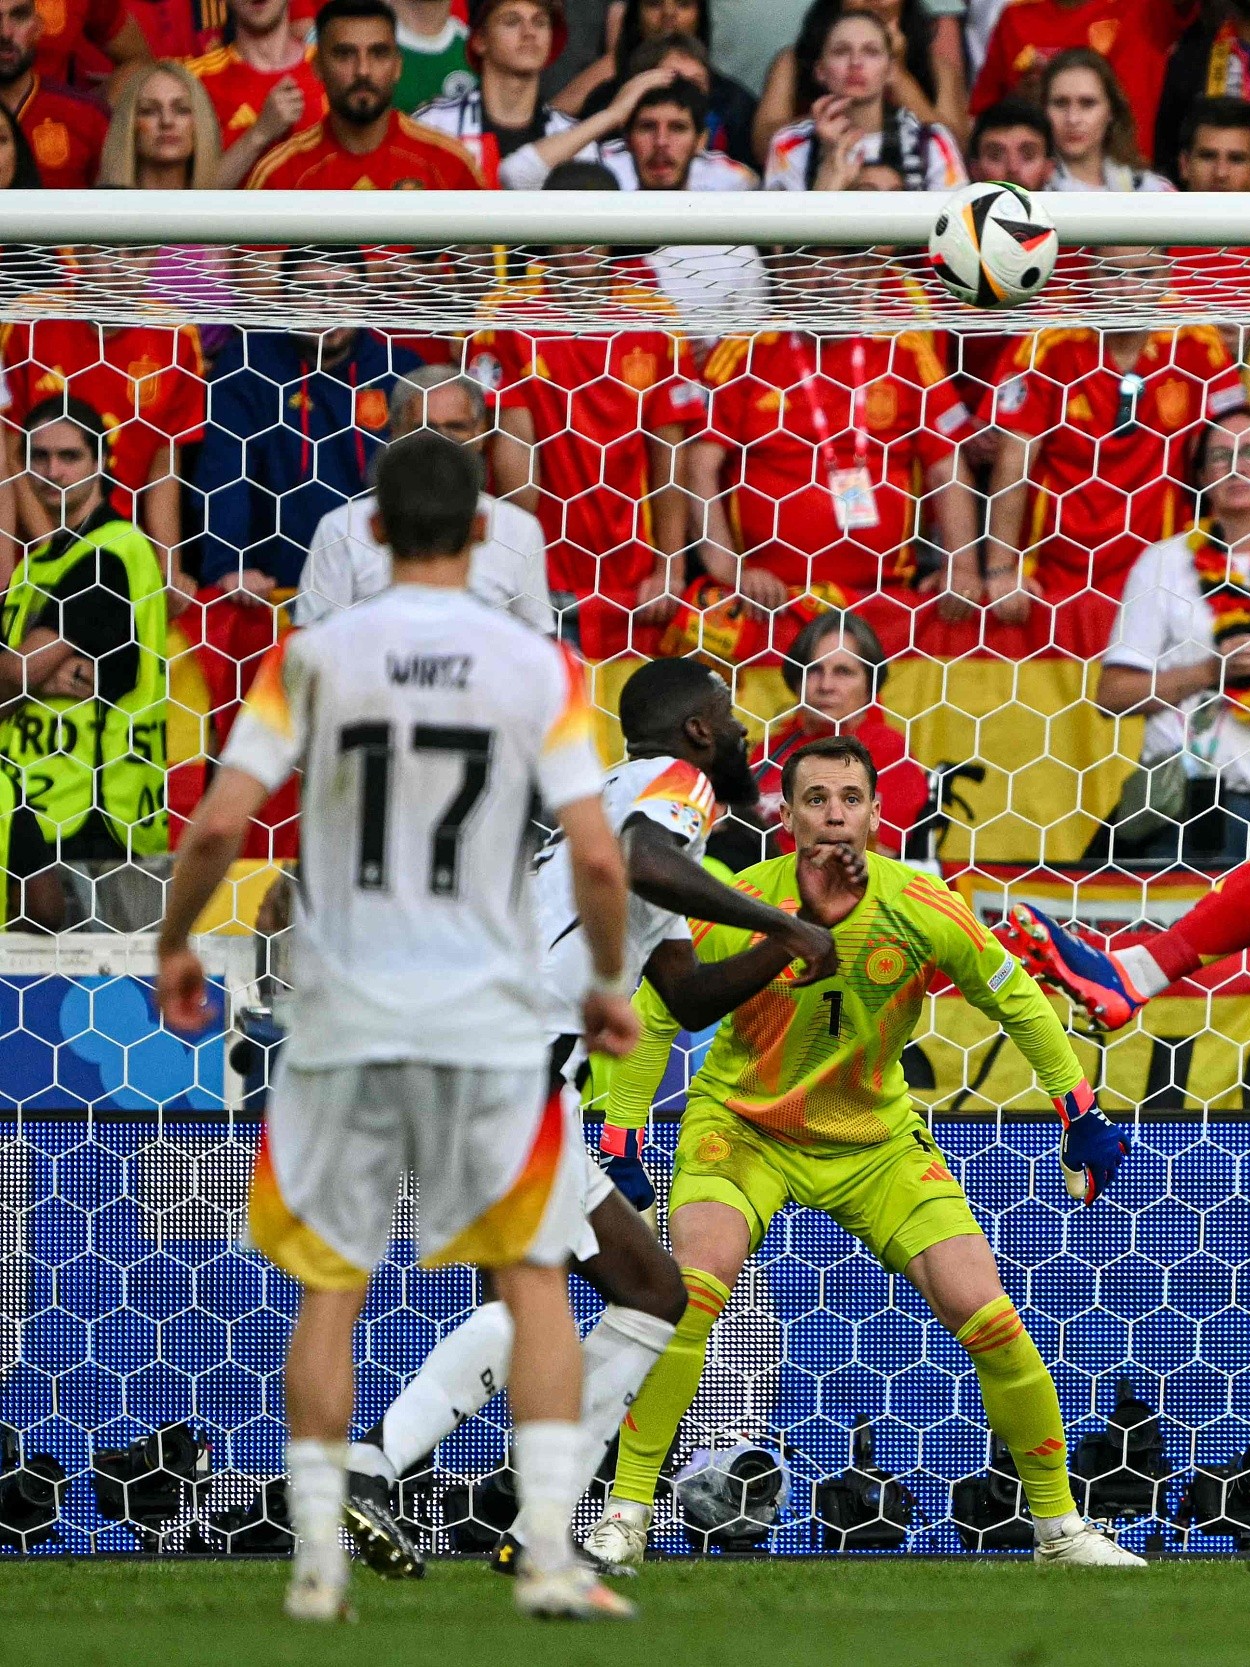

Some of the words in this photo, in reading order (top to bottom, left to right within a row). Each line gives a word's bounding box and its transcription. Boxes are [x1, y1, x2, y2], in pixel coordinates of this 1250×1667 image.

[386, 650, 473, 688] WIRTZ
[337, 718, 494, 896] 17
[822, 990, 843, 1038] 1
